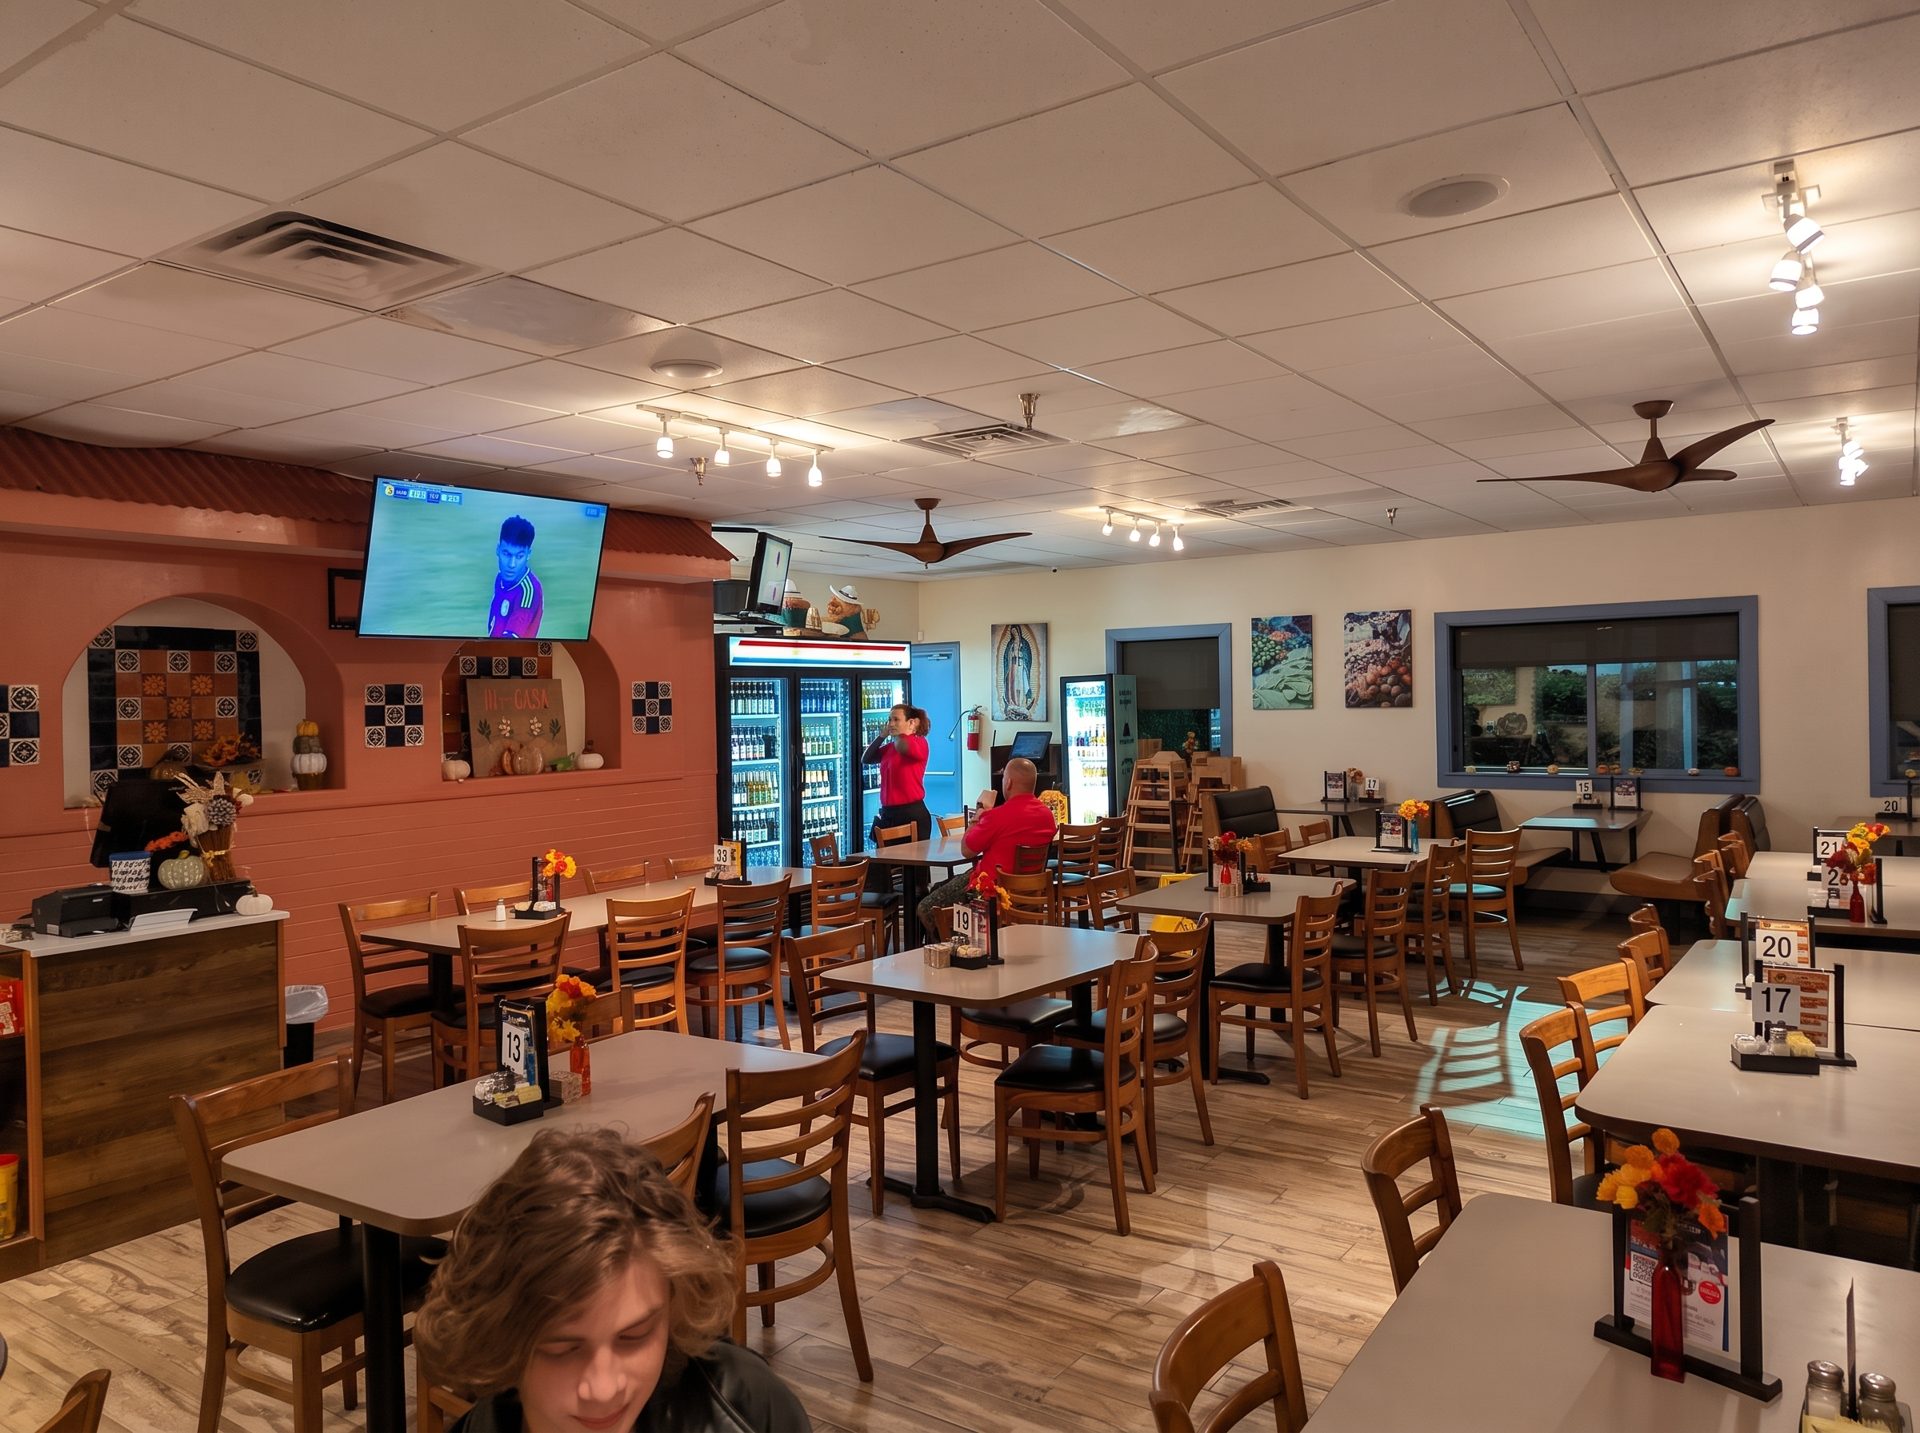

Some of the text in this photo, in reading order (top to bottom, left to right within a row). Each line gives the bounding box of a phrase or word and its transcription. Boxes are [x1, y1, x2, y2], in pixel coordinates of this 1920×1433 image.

[514, 687, 550, 711] CASA
[1368, 779, 1377, 789] 17
[1578, 782, 1589, 793] 15
[1884, 800, 1898, 812] 20
[716, 848, 728, 863] 33
[1821, 841, 1838, 855] 21
[956, 909, 969, 931] 19
[1762, 935, 1791, 958] 20
[1761, 987, 1791, 1013] 17
[506, 1031, 521, 1063] 13
